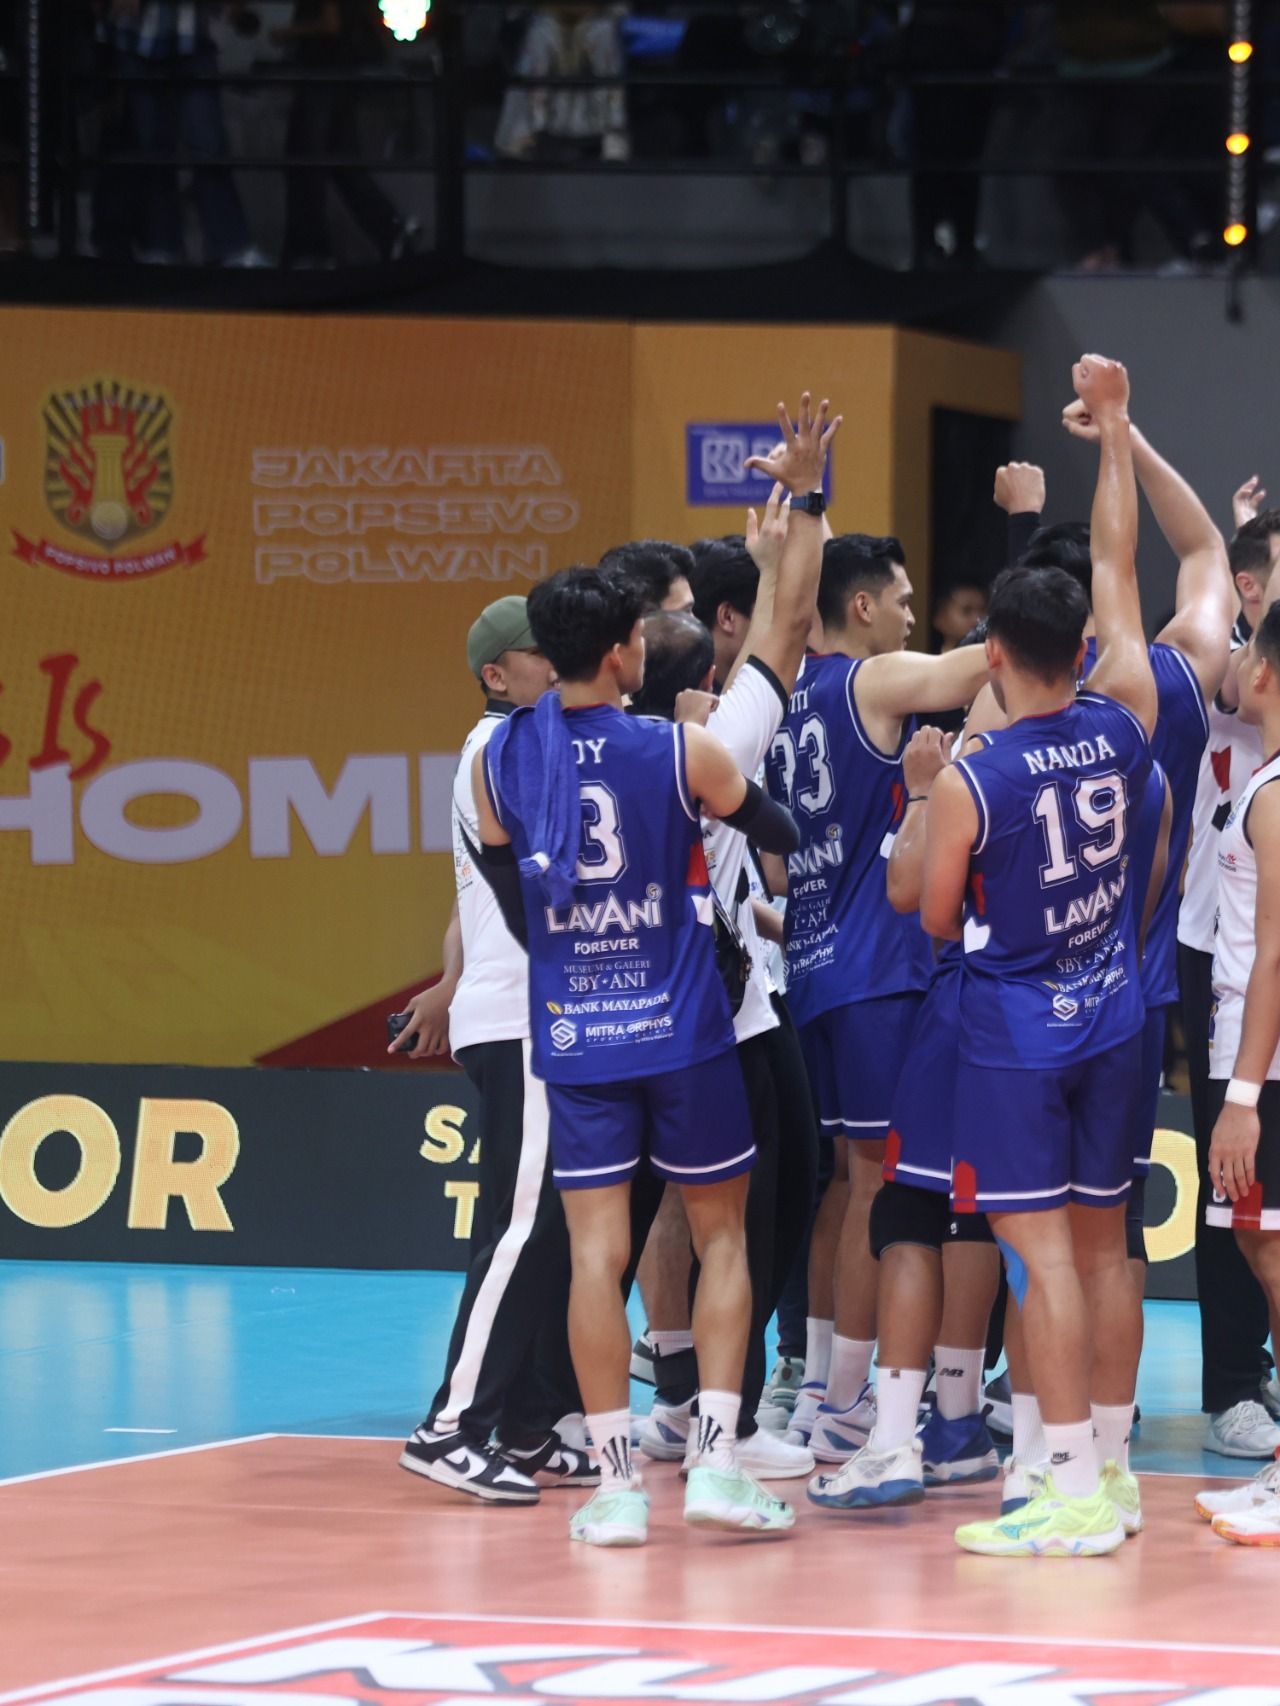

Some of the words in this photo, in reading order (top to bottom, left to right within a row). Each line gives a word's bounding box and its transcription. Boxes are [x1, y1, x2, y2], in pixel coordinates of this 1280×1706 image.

[251, 447, 562, 488] JAKARTA
[253, 496, 579, 536] POPSIVO
[255, 543, 548, 584] POLWAN
[1022, 733, 1116, 775] NANDA
[1031, 768, 1129, 889] 19
[574, 938, 639, 955] FOREVER
[569, 974, 601, 992] SBY
[610, 971, 648, 990] ANI
[563, 1001, 600, 1015] BANK
[602, 992, 670, 1012] MAYAPADA
[585, 1024, 625, 1038] MITRA
